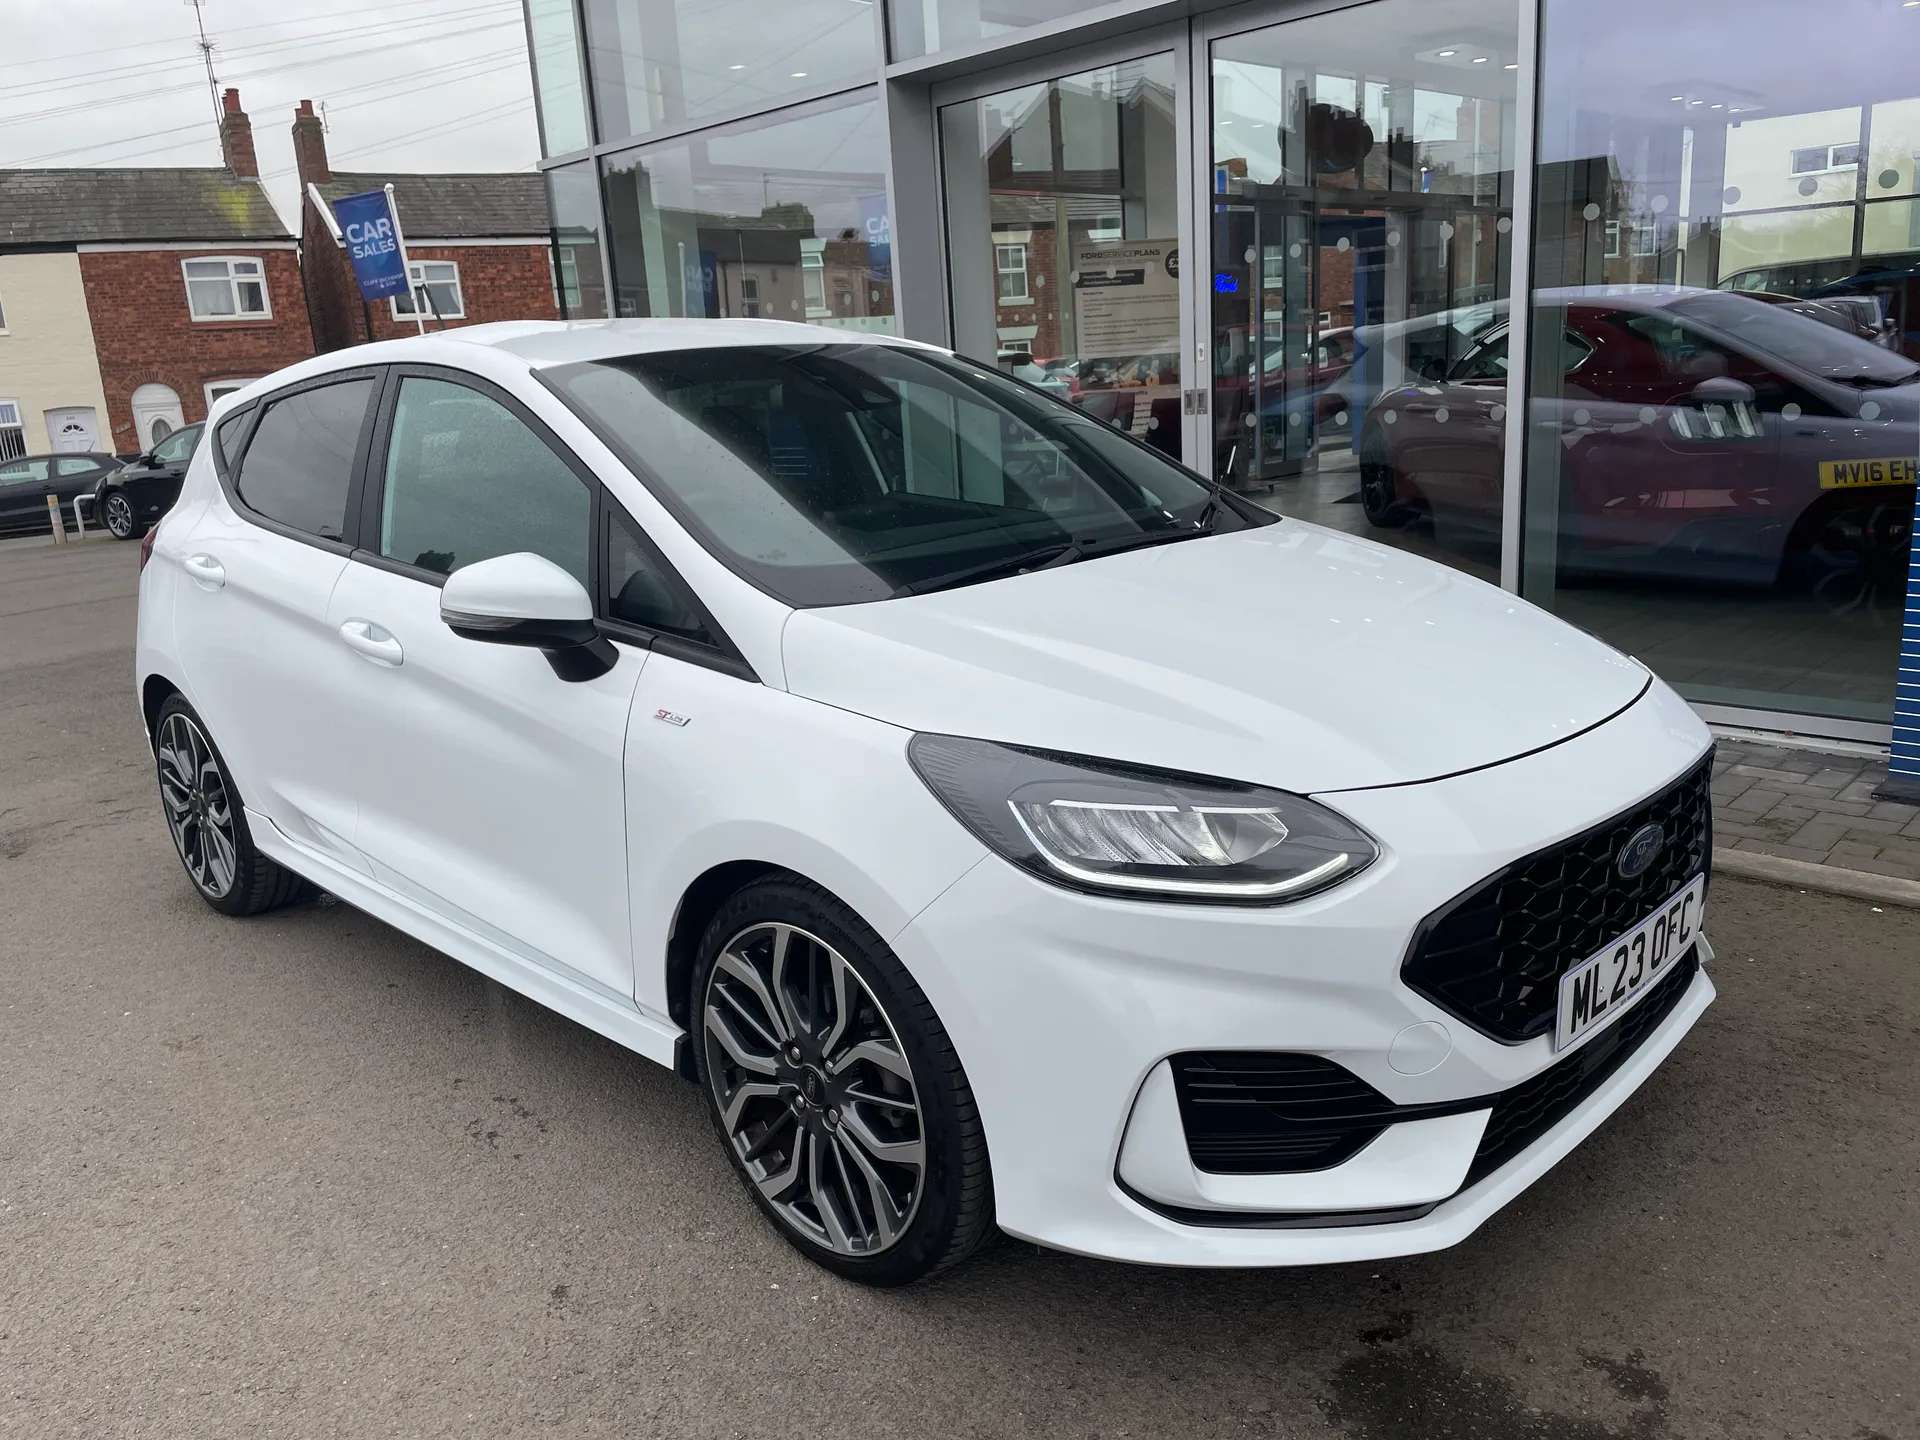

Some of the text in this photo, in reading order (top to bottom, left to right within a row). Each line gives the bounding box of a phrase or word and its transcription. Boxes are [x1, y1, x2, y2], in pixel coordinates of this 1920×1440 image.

[346, 217, 392, 243] CAR
[866, 215, 889, 234] CA
[353, 238, 396, 259] SALES
[1834, 459, 1917, 484] MV16 EH
[1571, 891, 1694, 1034] ML23 OFC
